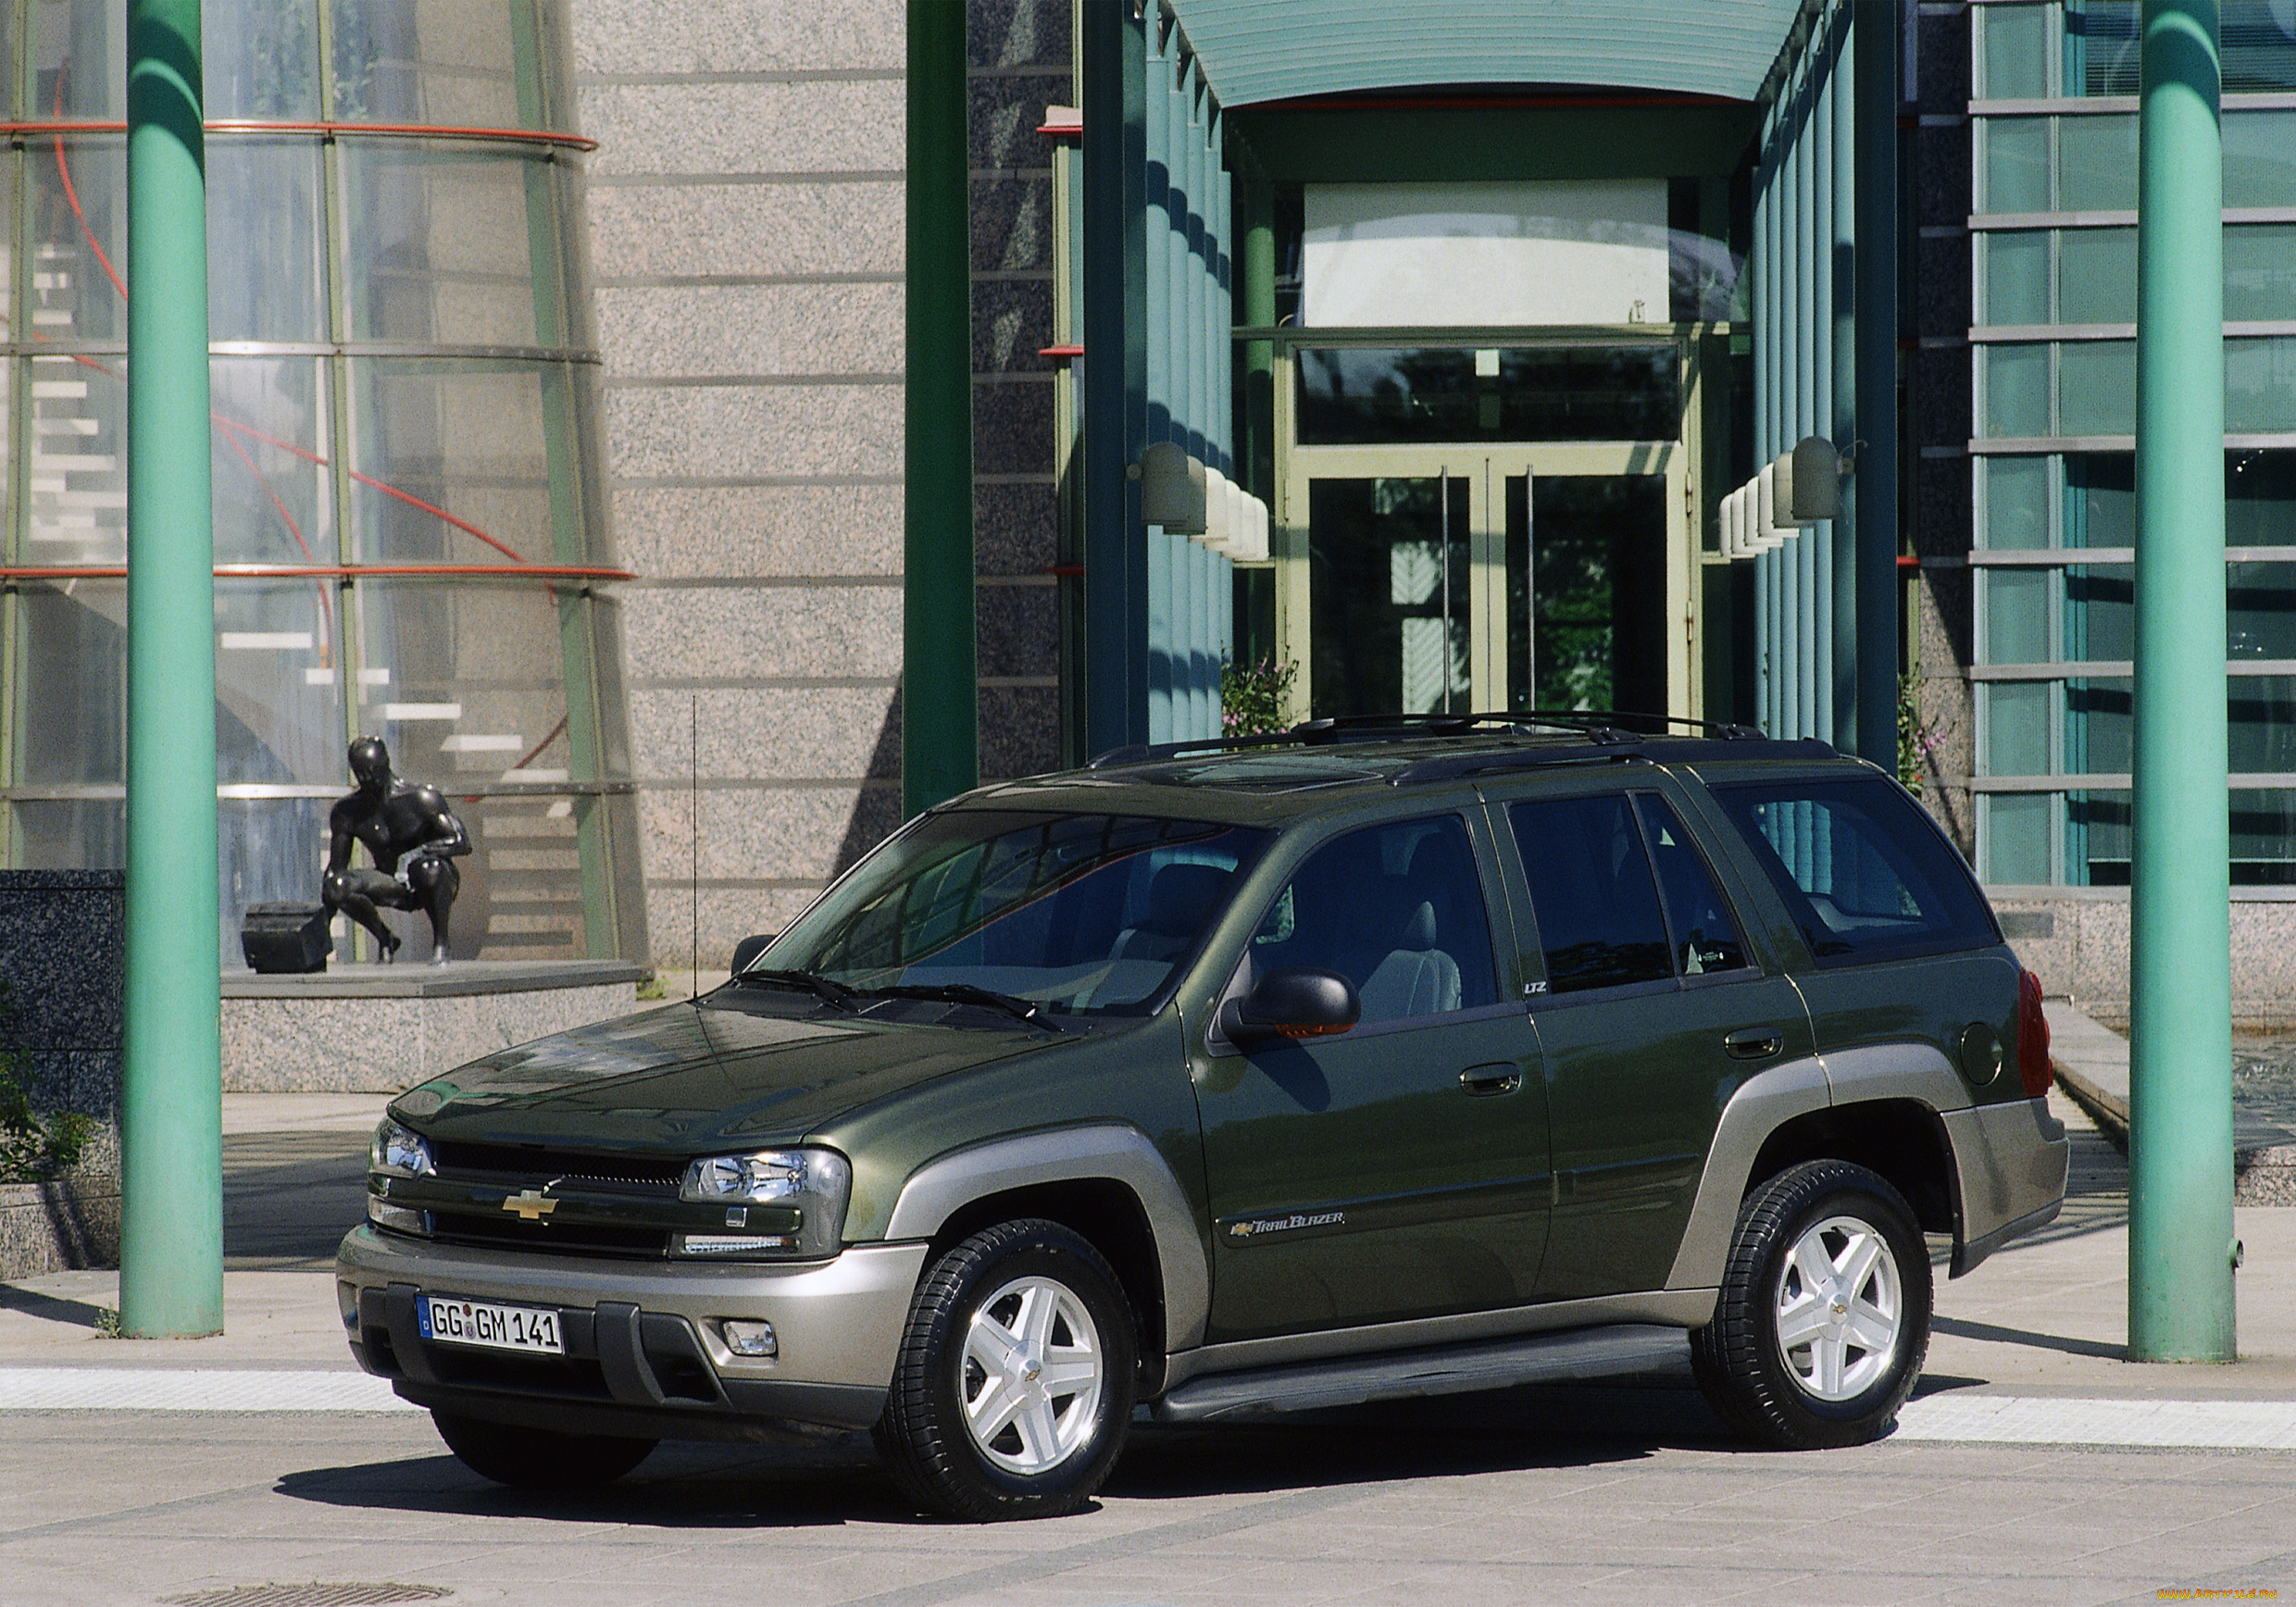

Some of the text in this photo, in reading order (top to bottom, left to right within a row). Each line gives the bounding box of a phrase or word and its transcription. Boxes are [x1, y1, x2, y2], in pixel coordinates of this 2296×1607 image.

[1524, 981, 1547, 994] LTZ
[422, 1320, 430, 1330] D
[432, 1303, 559, 1347] GG GM 141
